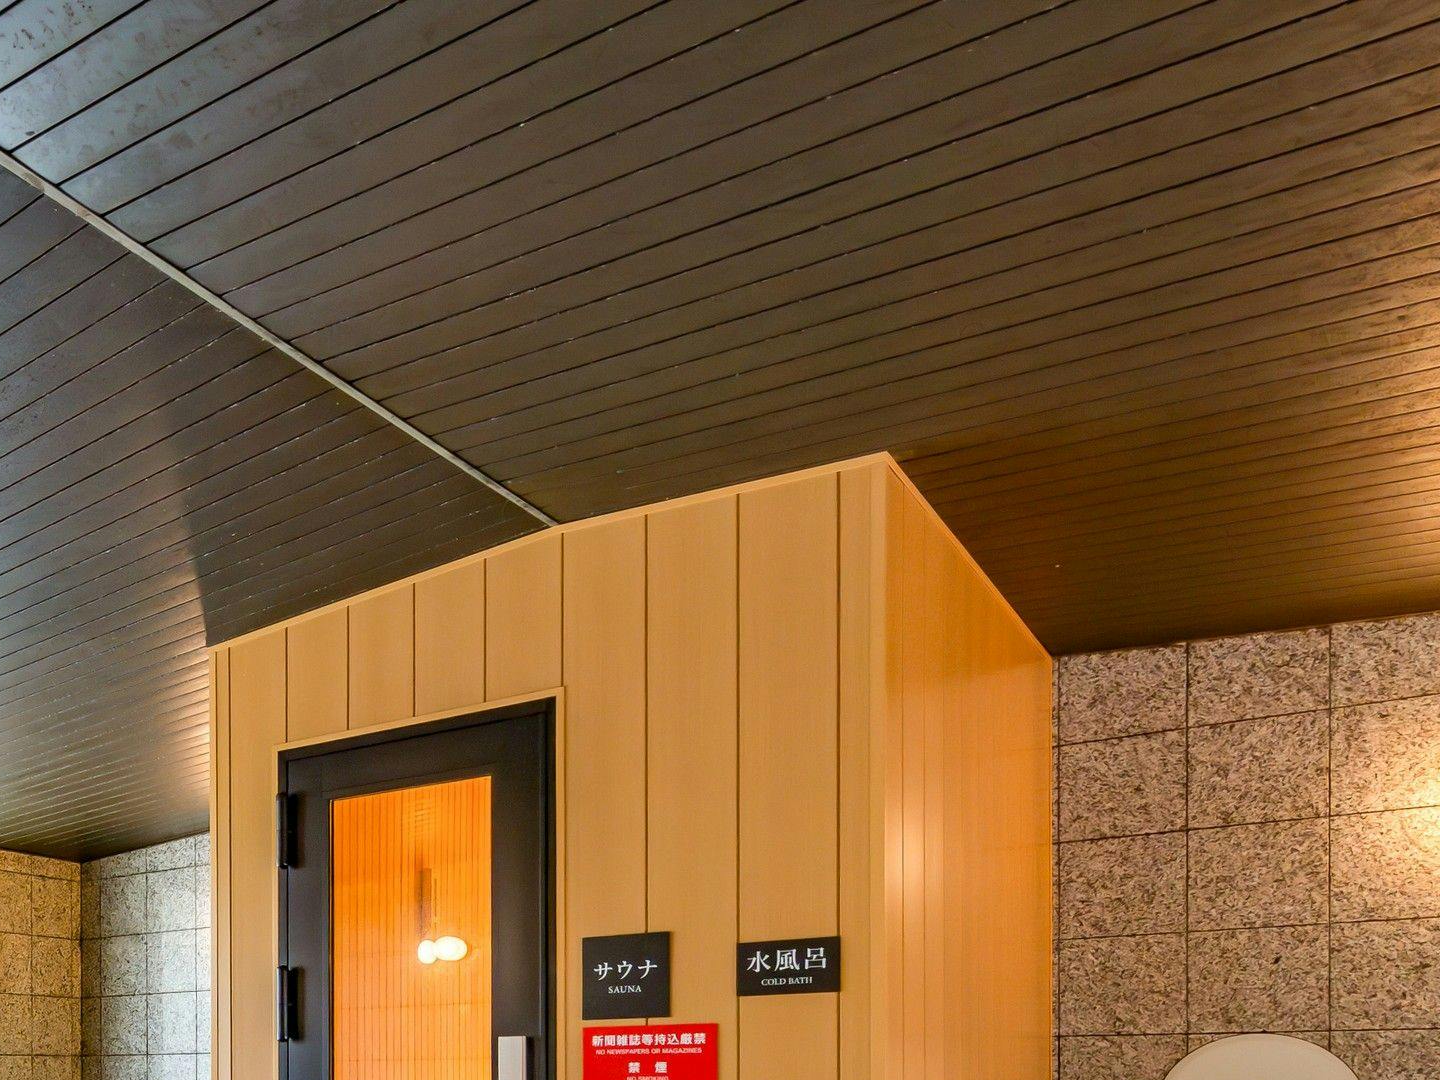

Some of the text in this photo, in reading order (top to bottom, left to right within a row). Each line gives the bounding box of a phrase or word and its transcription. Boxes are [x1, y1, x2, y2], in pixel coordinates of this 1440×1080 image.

[746, 947, 827, 973] 水風呂
[593, 959, 658, 981] サウナ
[761, 976, 813, 986] COLD BATH
[607, 985, 642, 994] SAUNA
[591, 1032, 706, 1047] 新聞雑誌等持込厳禁
